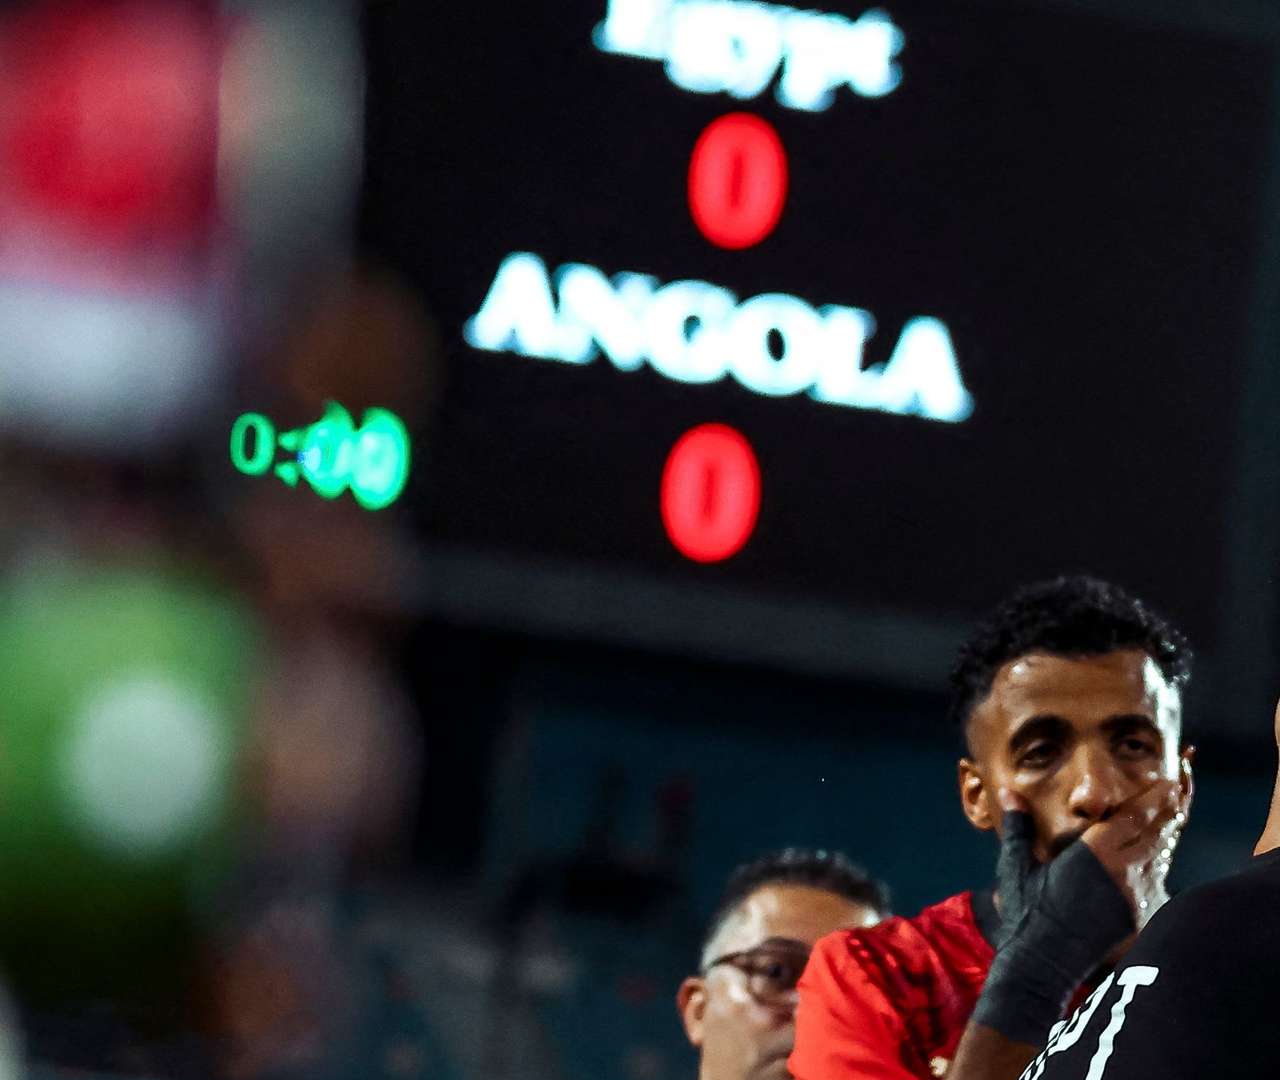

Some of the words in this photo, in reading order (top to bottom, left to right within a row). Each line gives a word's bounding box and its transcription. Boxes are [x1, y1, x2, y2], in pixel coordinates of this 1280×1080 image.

[688, 112, 788, 250] 0
[464, 252, 972, 422] ANGOLA
[660, 423, 761, 564] 0
